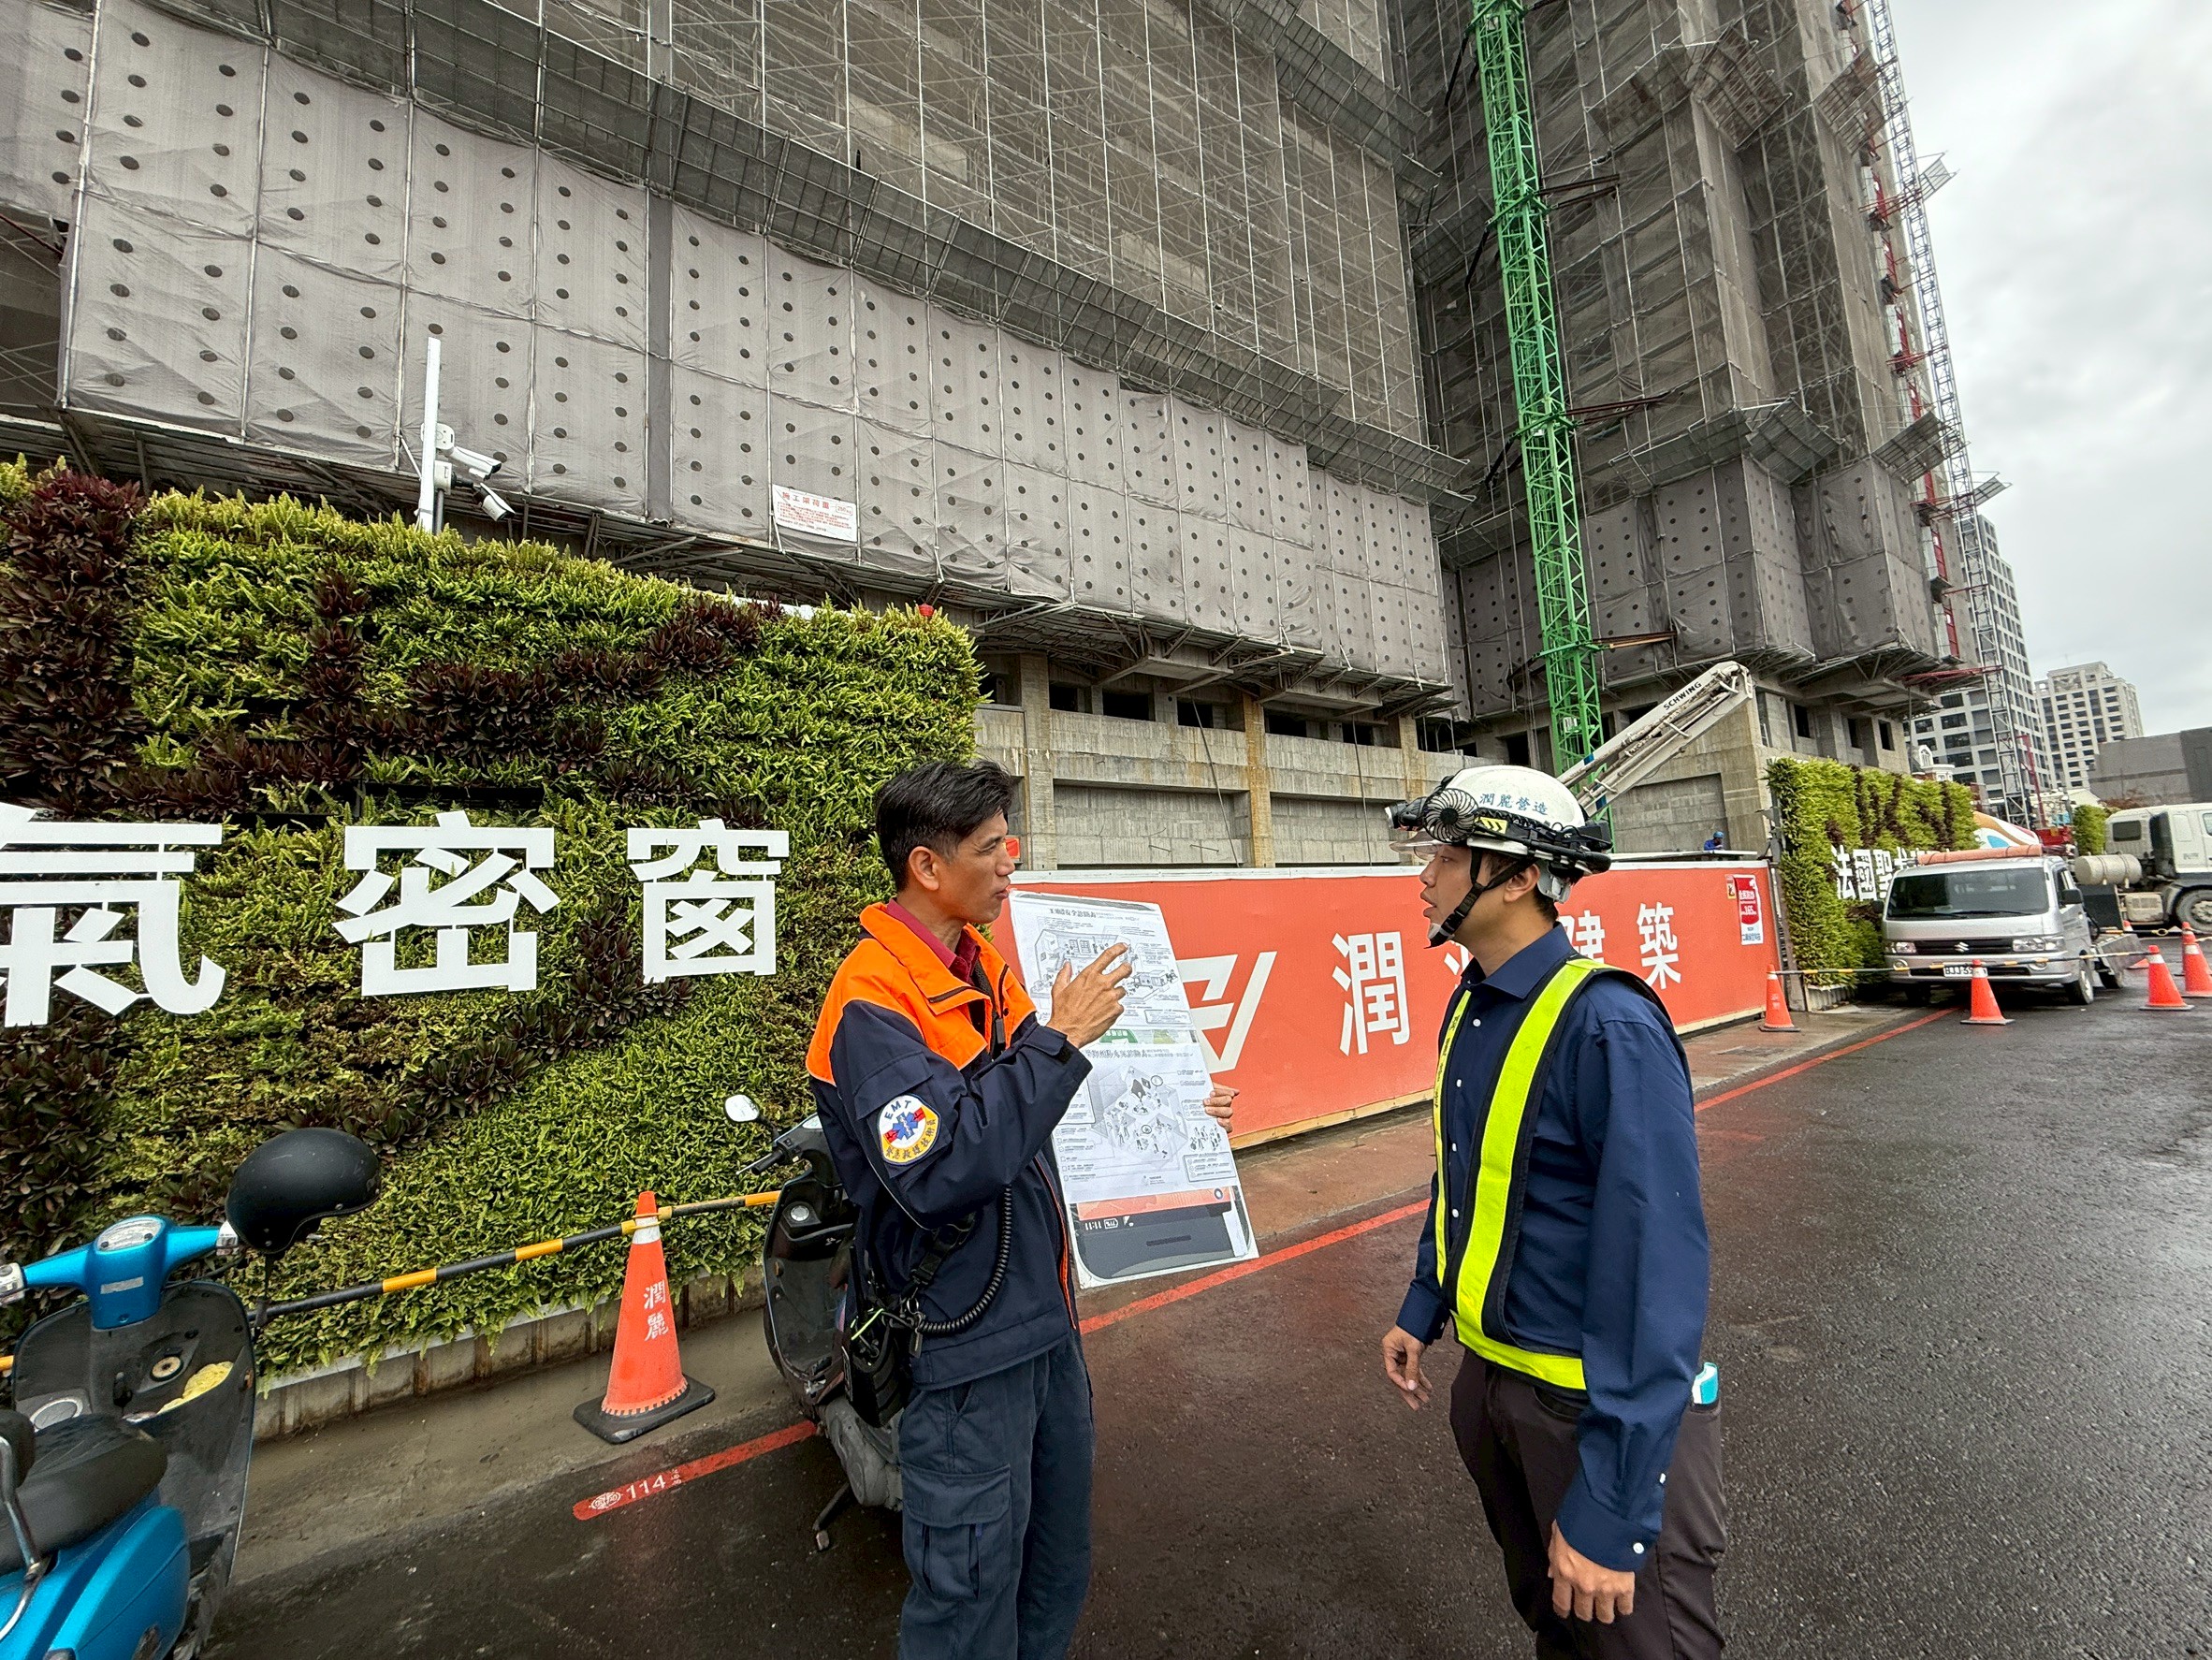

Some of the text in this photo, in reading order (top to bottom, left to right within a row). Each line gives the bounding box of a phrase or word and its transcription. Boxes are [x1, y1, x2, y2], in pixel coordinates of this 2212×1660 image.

[1663, 680, 1703, 711] SCHWING
[1479, 793, 1549, 816] 潤麗營造
[0, 803, 790, 1027] 氣密窗
[1332, 901, 1681, 1056] 潤建築
[884, 1099, 911, 1120] EMT
[643, 1279, 669, 1342] 潤麗
[626, 1474, 666, 1500] 114
